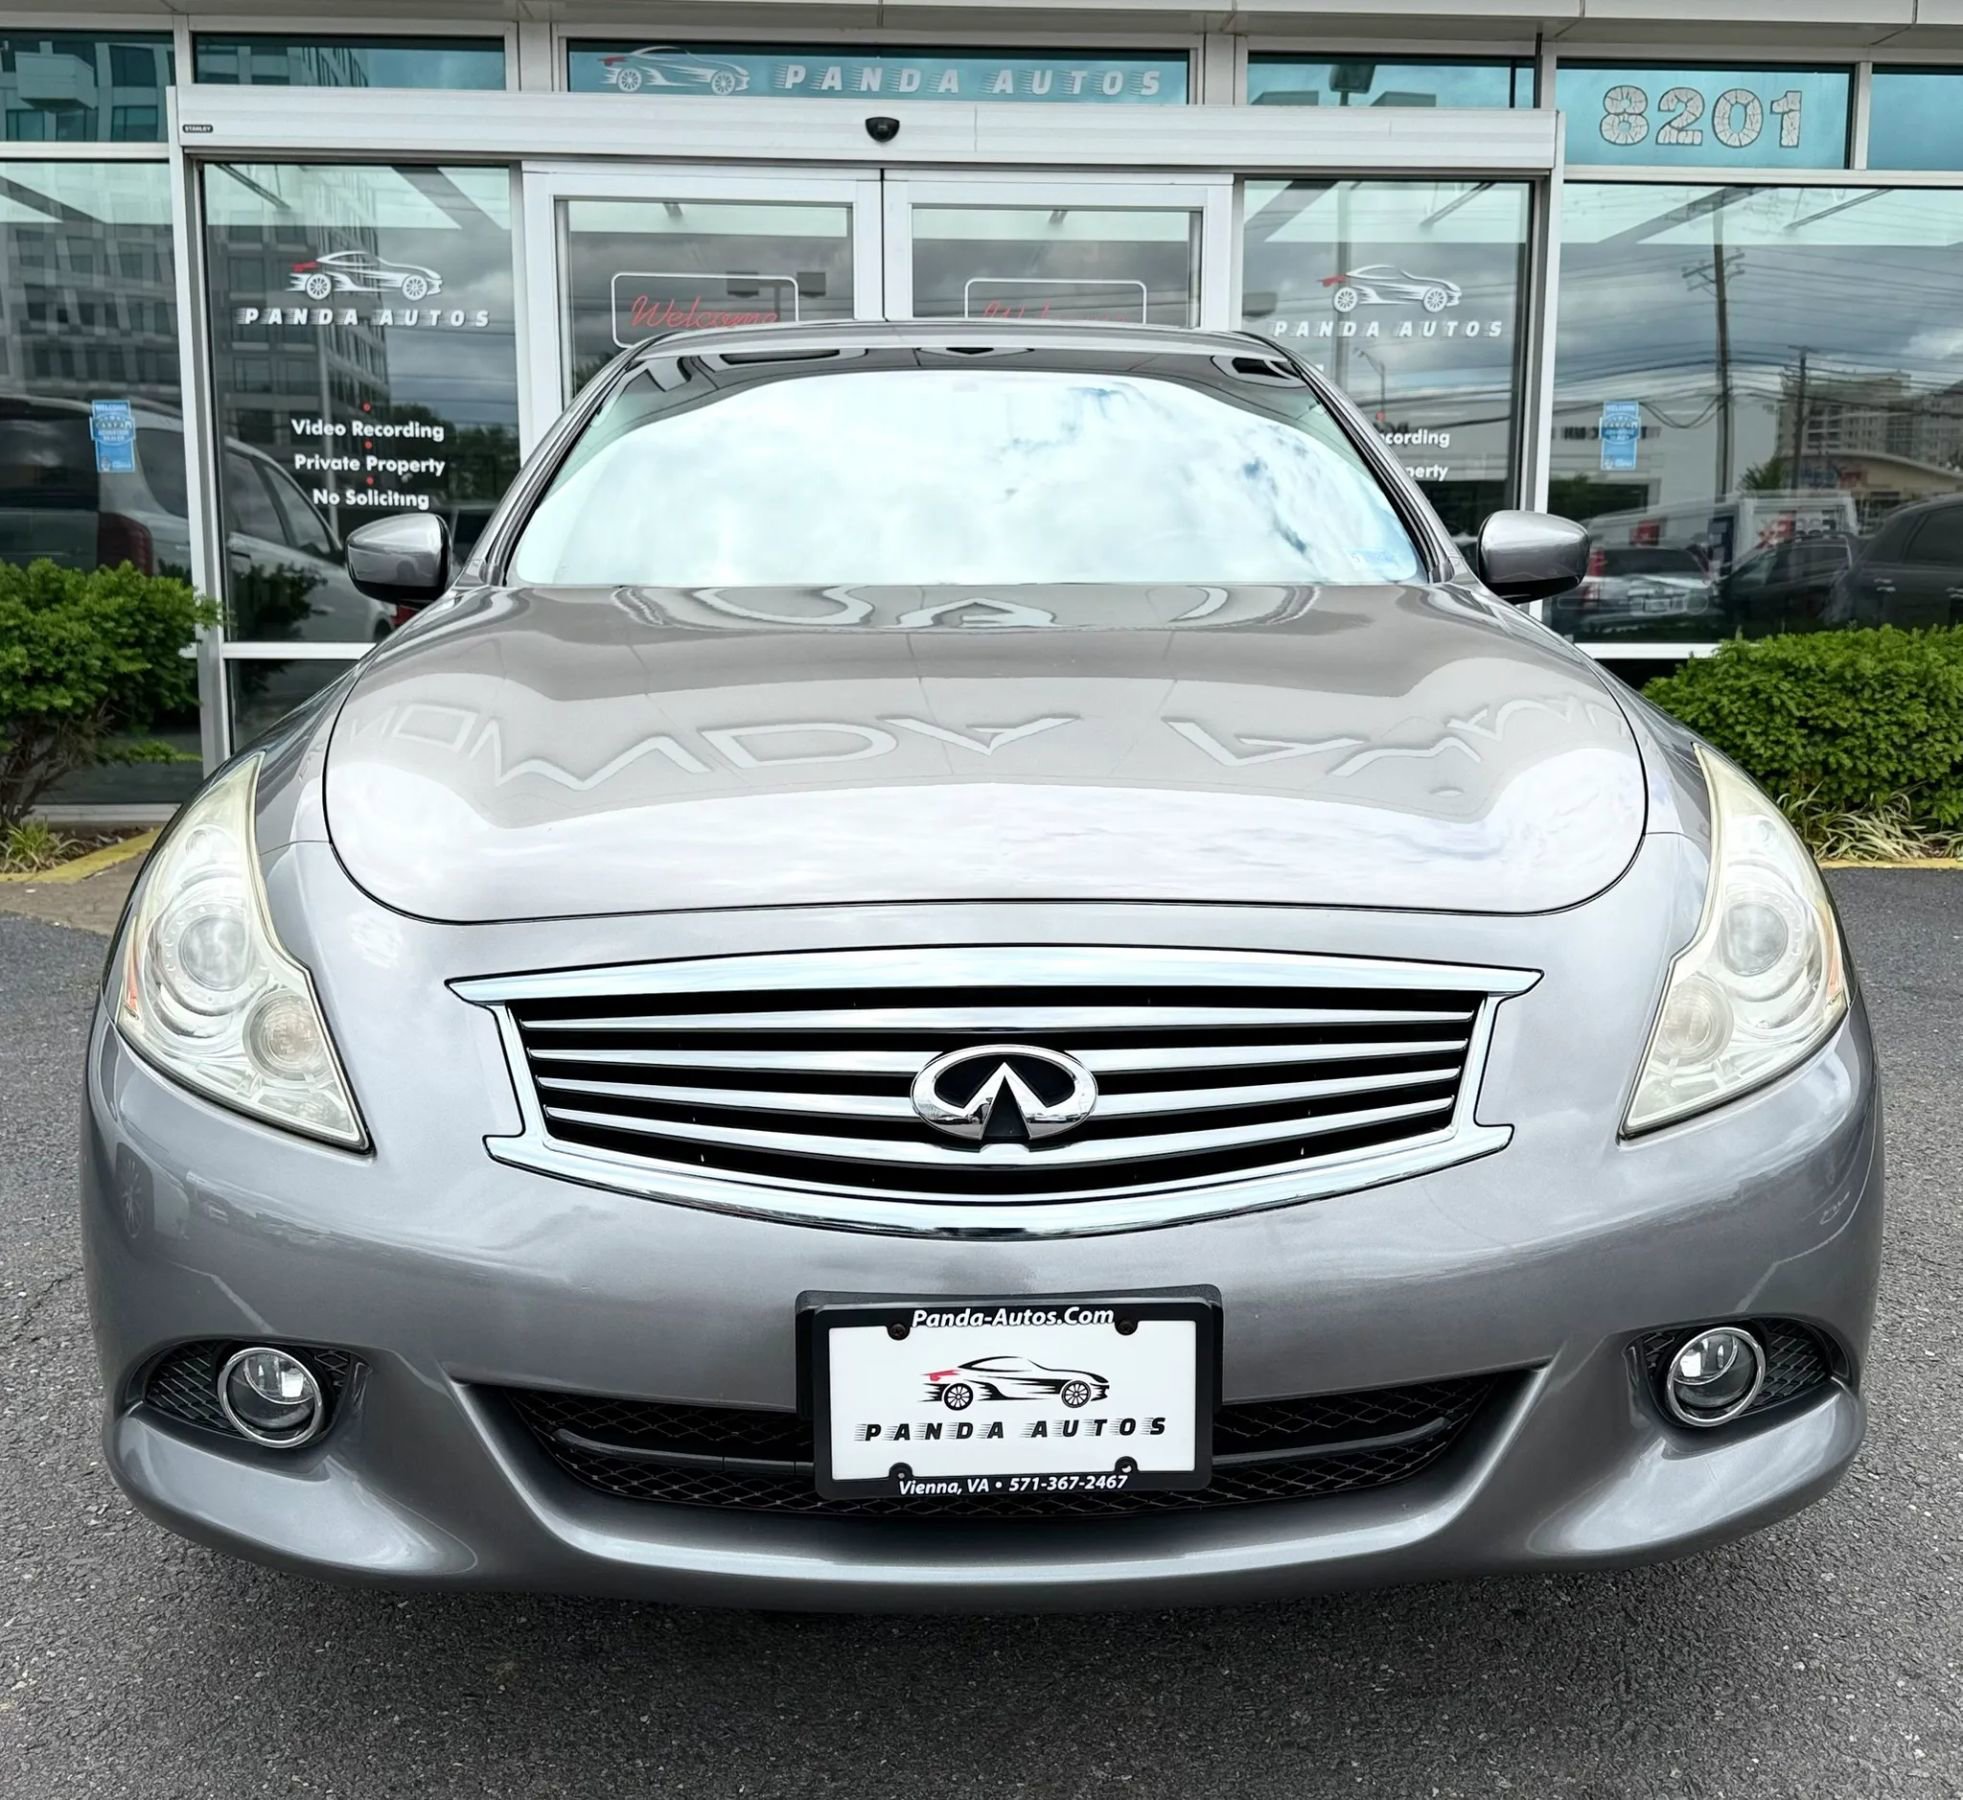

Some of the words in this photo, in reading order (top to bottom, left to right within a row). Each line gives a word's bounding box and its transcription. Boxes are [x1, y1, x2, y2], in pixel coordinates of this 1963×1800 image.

[773, 64, 960, 93] PANDA
[979, 69, 1161, 96] AUTOS
[1600, 85, 1803, 149] 8201
[238, 307, 359, 326] PANDA
[371, 308, 490, 328] AUTOS
[1270, 320, 1380, 337] PANDA
[1393, 320, 1503, 337] AUTOS
[291, 418, 347, 437] Video
[351, 420, 445, 442] Recording
[1380, 427, 1451, 449] cording
[294, 454, 361, 472] Private
[366, 455, 446, 478] Property
[312, 489, 341, 506] No
[345, 489, 430, 511] Soliciting
[911, 1306, 1115, 1329] Panda-Autos.Com
[853, 1422, 1005, 1442] PANDA
[1017, 1416, 1167, 1440] AUTOS
[899, 1480, 963, 1496] Vienna,
[966, 1479, 990, 1493] VA
[1008, 1474, 1129, 1493] 571-367-2467
